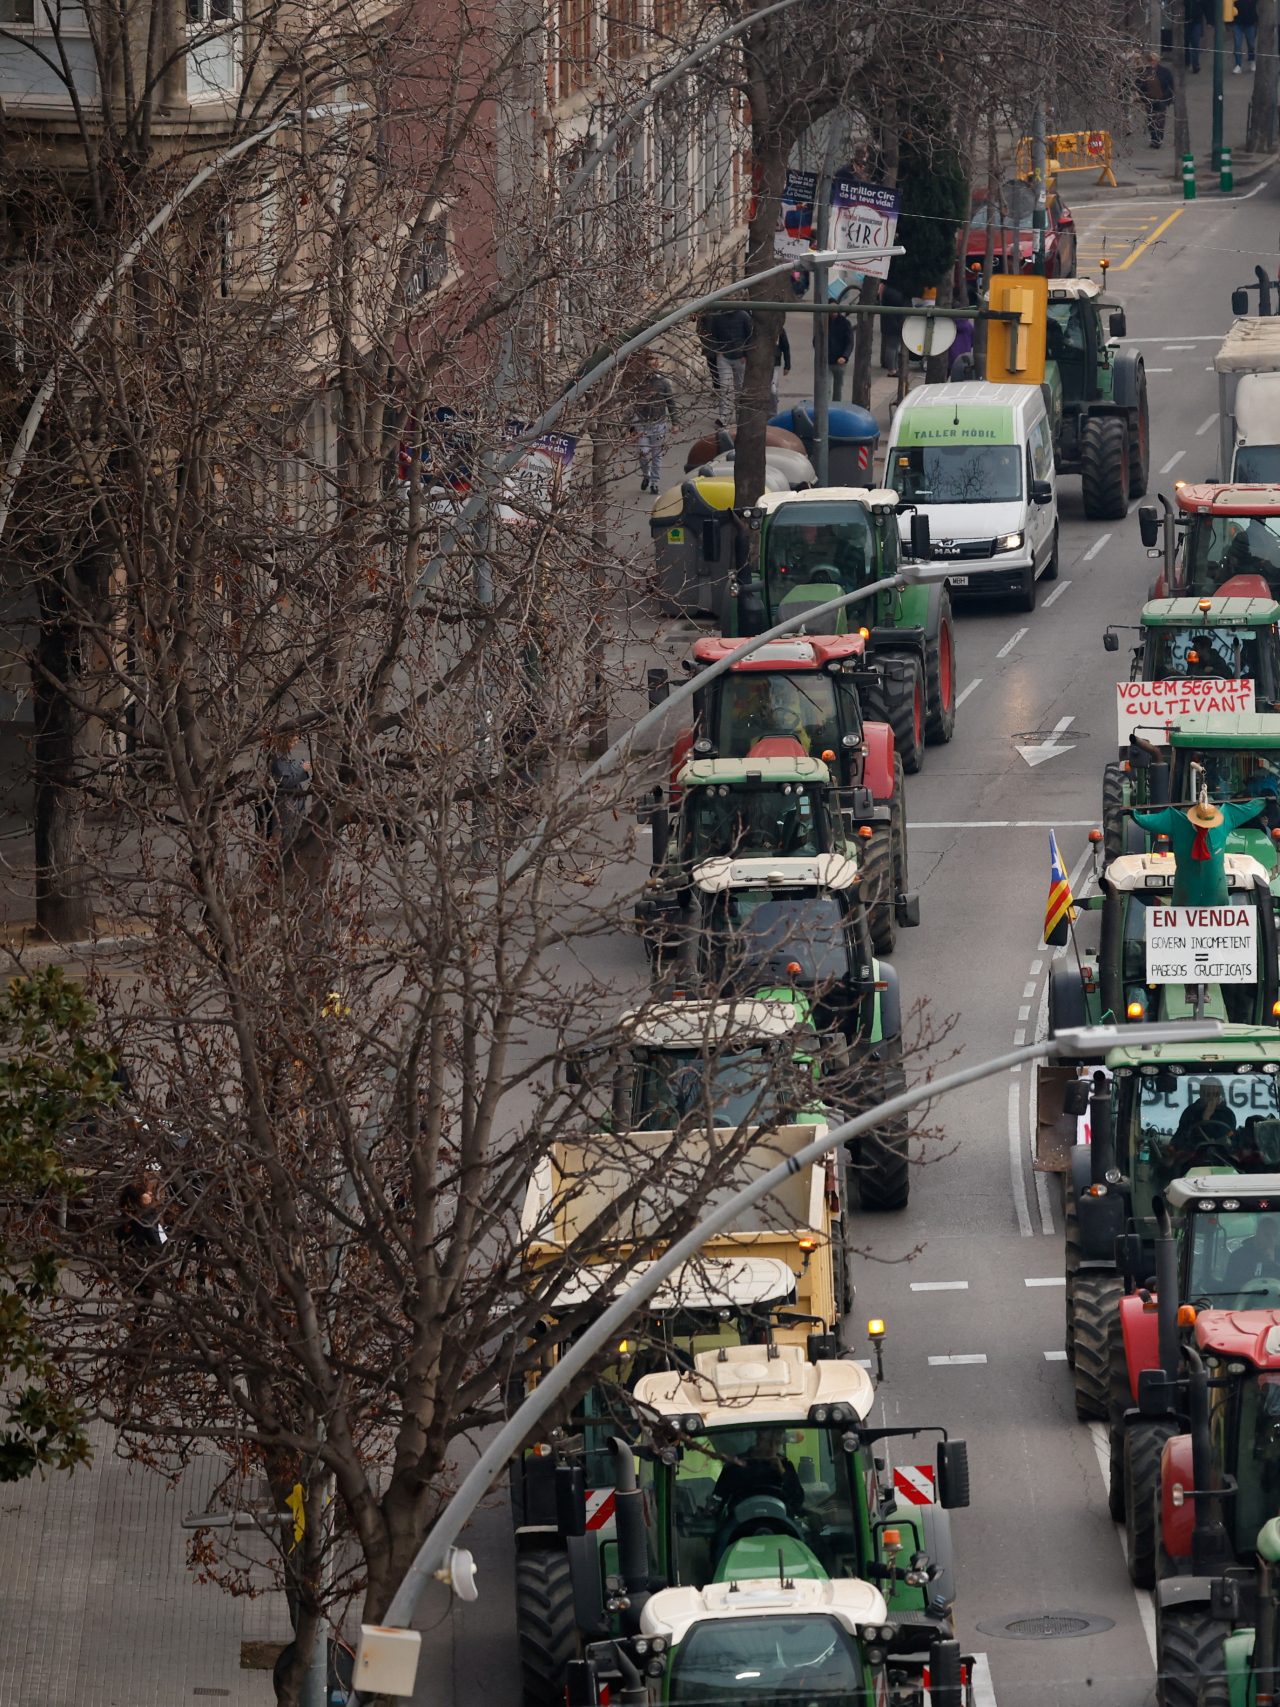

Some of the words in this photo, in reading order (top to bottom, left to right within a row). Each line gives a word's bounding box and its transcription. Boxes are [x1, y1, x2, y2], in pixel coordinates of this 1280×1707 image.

[840, 183, 849, 192] El
[850, 186, 876, 197] millor
[877, 191, 895, 201] Circ
[859, 195, 875, 204] teva
[876, 199, 894, 208] vida!
[914, 429, 957, 440] TALLER
[1117, 681, 1177, 698] VOLEM
[1182, 679, 1251, 696] SEGUIR
[1126, 694, 1250, 715] CULTIVANT
[1153, 910, 1177, 927] EN
[1185, 909, 1250, 927] VENDA
[1151, 936, 1186, 949] GOVERN
[1191, 936, 1251, 949] INCOMPETENT
[1151, 964, 1188, 977] PAGESOS
[1194, 963, 1252, 977] CRUCIFICATS
